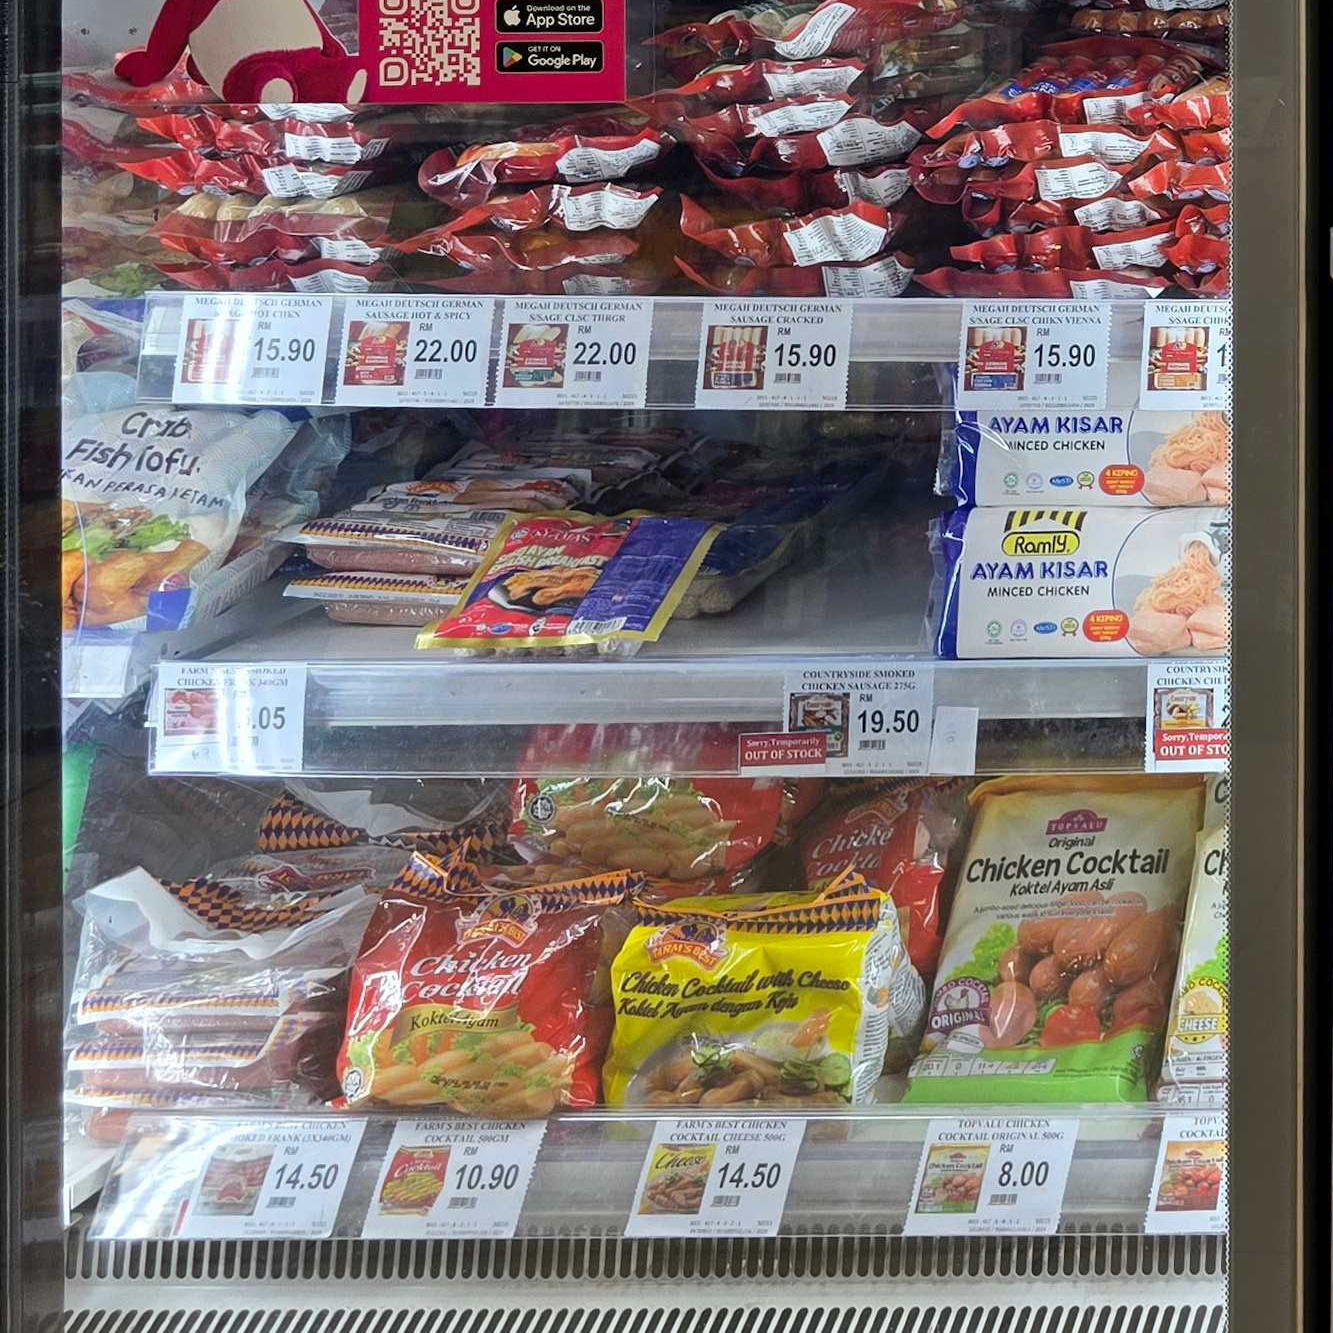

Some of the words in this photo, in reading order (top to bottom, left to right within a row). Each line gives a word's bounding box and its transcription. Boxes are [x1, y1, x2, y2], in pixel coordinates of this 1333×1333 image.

[527, 4, 563, 12] Download
[577, 4, 591, 12] the
[526, 13, 555, 28] App
[557, 13, 595, 26] Store
[528, 54, 570, 69] Google
[572, 54, 596, 69] Play
[414, 339, 477, 363] 22.00
[774, 344, 836, 367] 15.90
[970, 560, 1035, 579] AYAM
[1039, 560, 1108, 578] KISAR
[987, 586, 1035, 598] MINCED
[1038, 584, 1090, 597] CHICKEN
[857, 711, 919, 733] 19.50
[745, 748, 771, 760] OUT
[774, 748, 789, 759] OF
[792, 747, 822, 759] STOCK
[1049, 835, 1095, 848] Original
[967, 855, 1060, 883] Chicken
[1066, 851, 1169, 877] Cocktail
[1010, 881, 1049, 896] Koktel
[1052, 881, 1086, 895] Ayam
[1090, 879, 1113, 892] Asli
[932, 1009, 988, 1027] ORIGINAL
[454, 1165, 518, 1190] 10.90
[717, 1162, 781, 1188] 14.50
[998, 1162, 1049, 1187] 8.00
